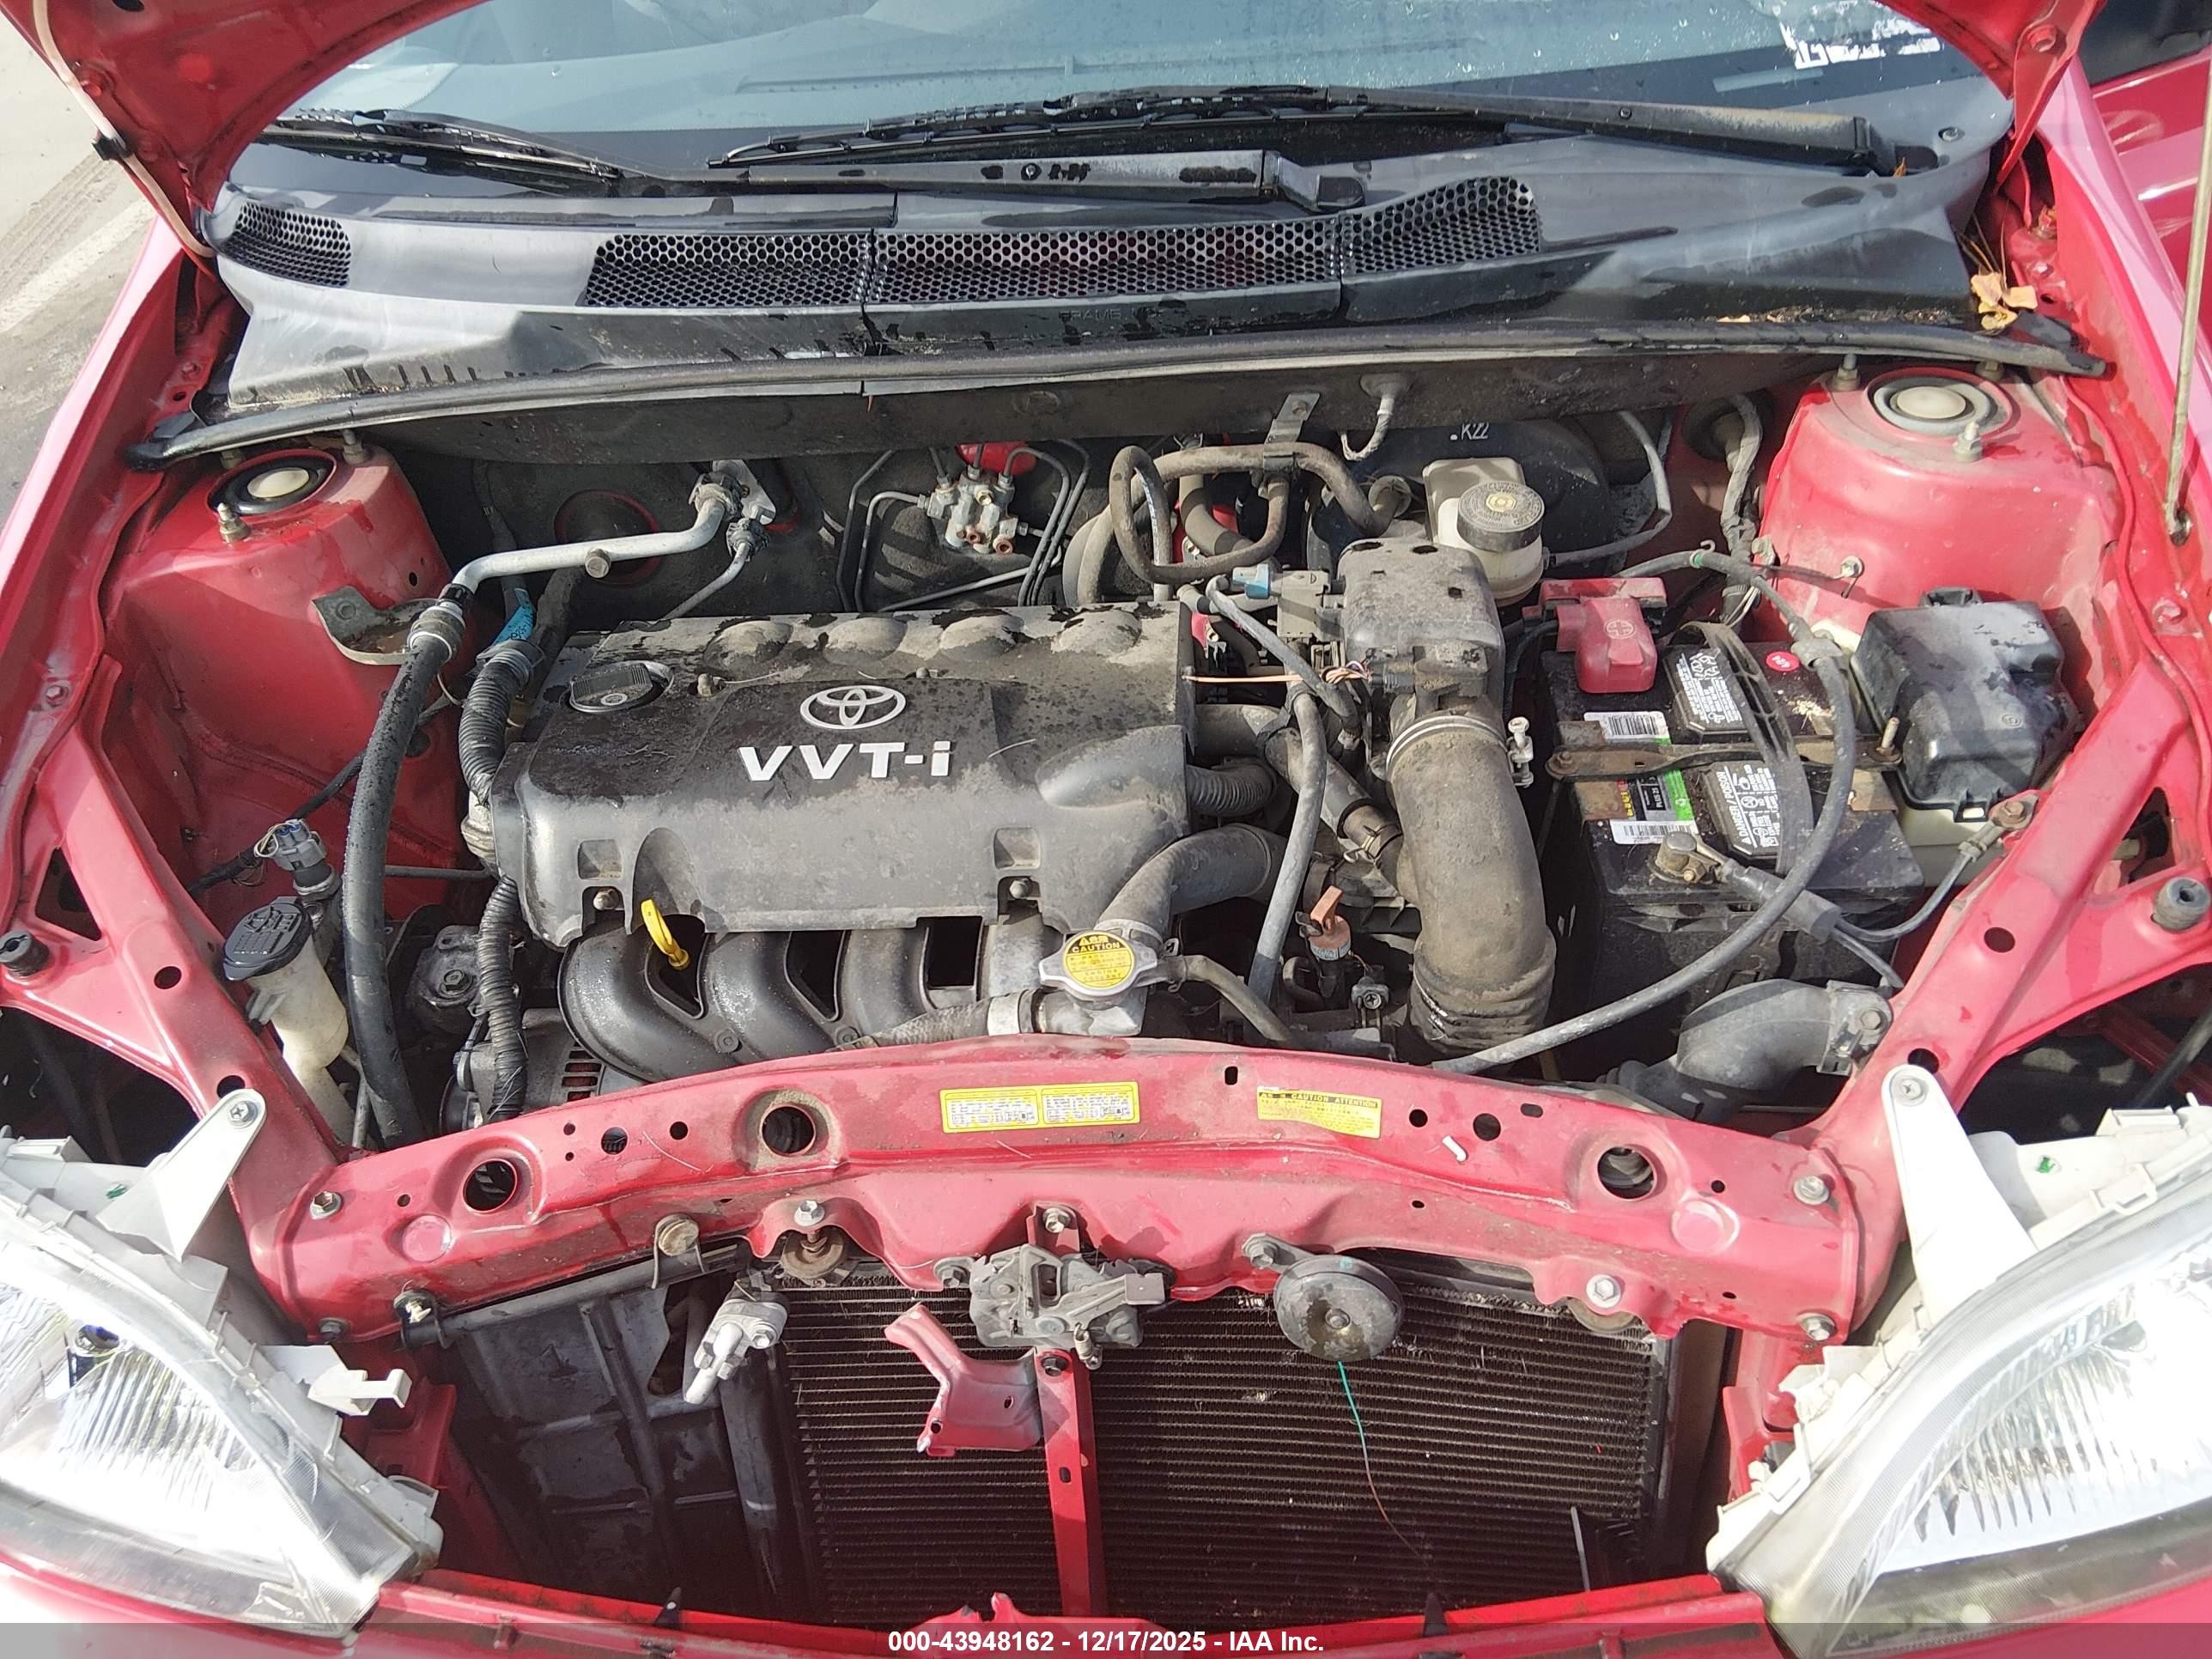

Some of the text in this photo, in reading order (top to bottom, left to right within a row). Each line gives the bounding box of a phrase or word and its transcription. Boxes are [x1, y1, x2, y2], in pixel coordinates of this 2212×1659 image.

[738, 740, 951, 781] VVT-i
[1716, 771, 1735, 799] POISON
[1728, 805, 1751, 837] DANGER
[1072, 942, 1121, 953] CAUTION
[1291, 1093, 1330, 1103] CAUTION
